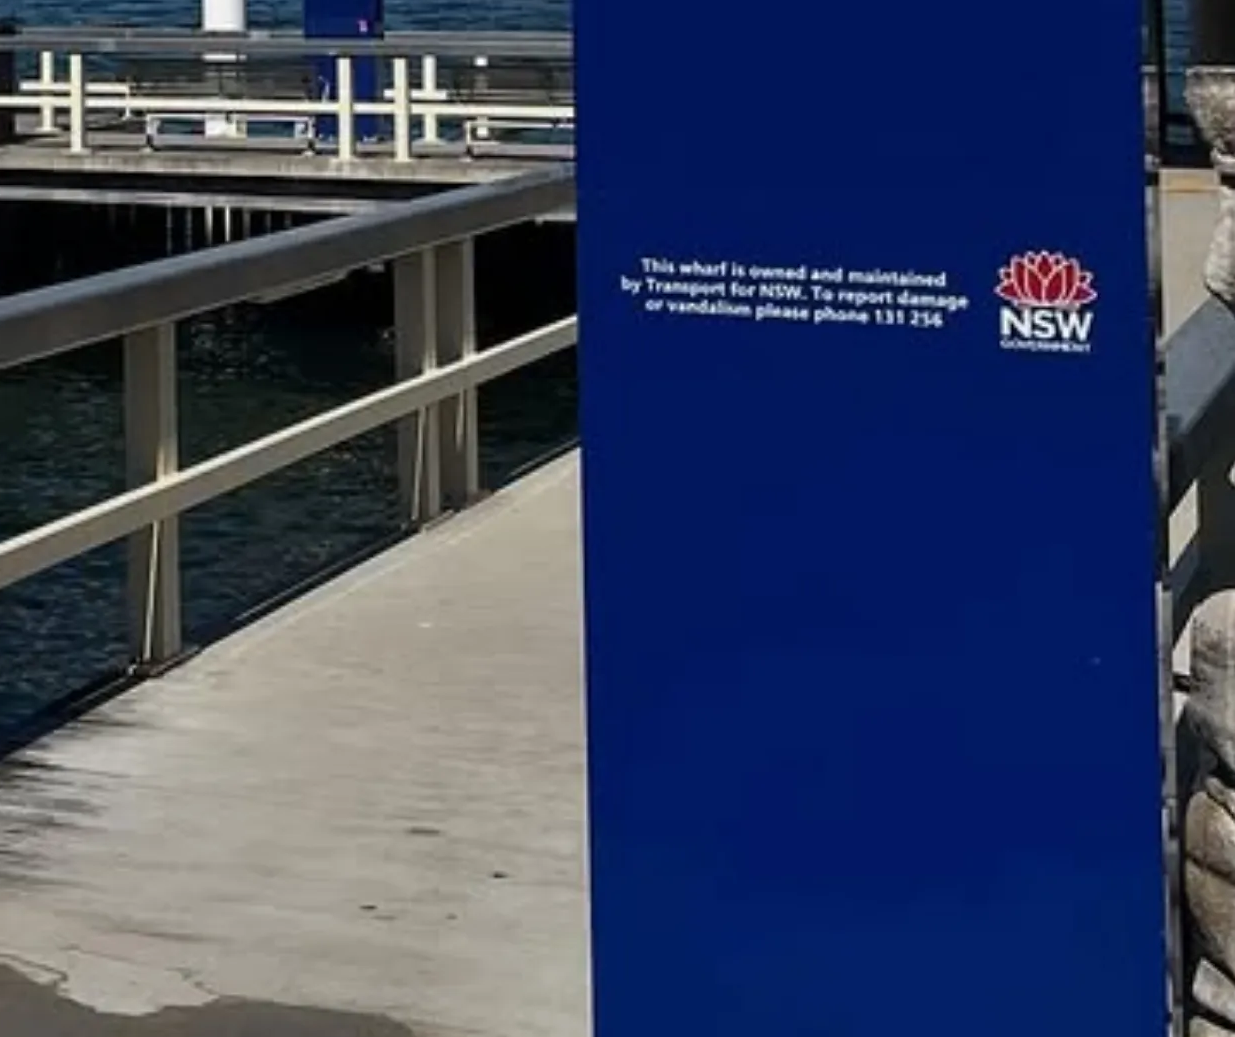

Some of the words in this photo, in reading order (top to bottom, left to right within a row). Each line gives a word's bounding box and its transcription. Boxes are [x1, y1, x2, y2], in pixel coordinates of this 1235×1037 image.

[641, 257, 674, 275] This
[679, 260, 726, 276] wharf
[731, 261, 746, 277] is
[749, 264, 807, 280] owned
[811, 267, 843, 283] and
[848, 268, 946, 287] maintained
[621, 275, 642, 295] by
[645, 277, 725, 297] Transport
[731, 281, 756, 297] for
[759, 283, 808, 300] NSW.
[811, 285, 833, 301] To
[837, 291, 892, 307] report
[897, 290, 969, 311] damage
[645, 299, 663, 311] or
[667, 299, 752, 316] vandalism
[755, 303, 810, 321] please
[814, 306, 868, 325] phone
[999, 306, 1094, 341] NSW
